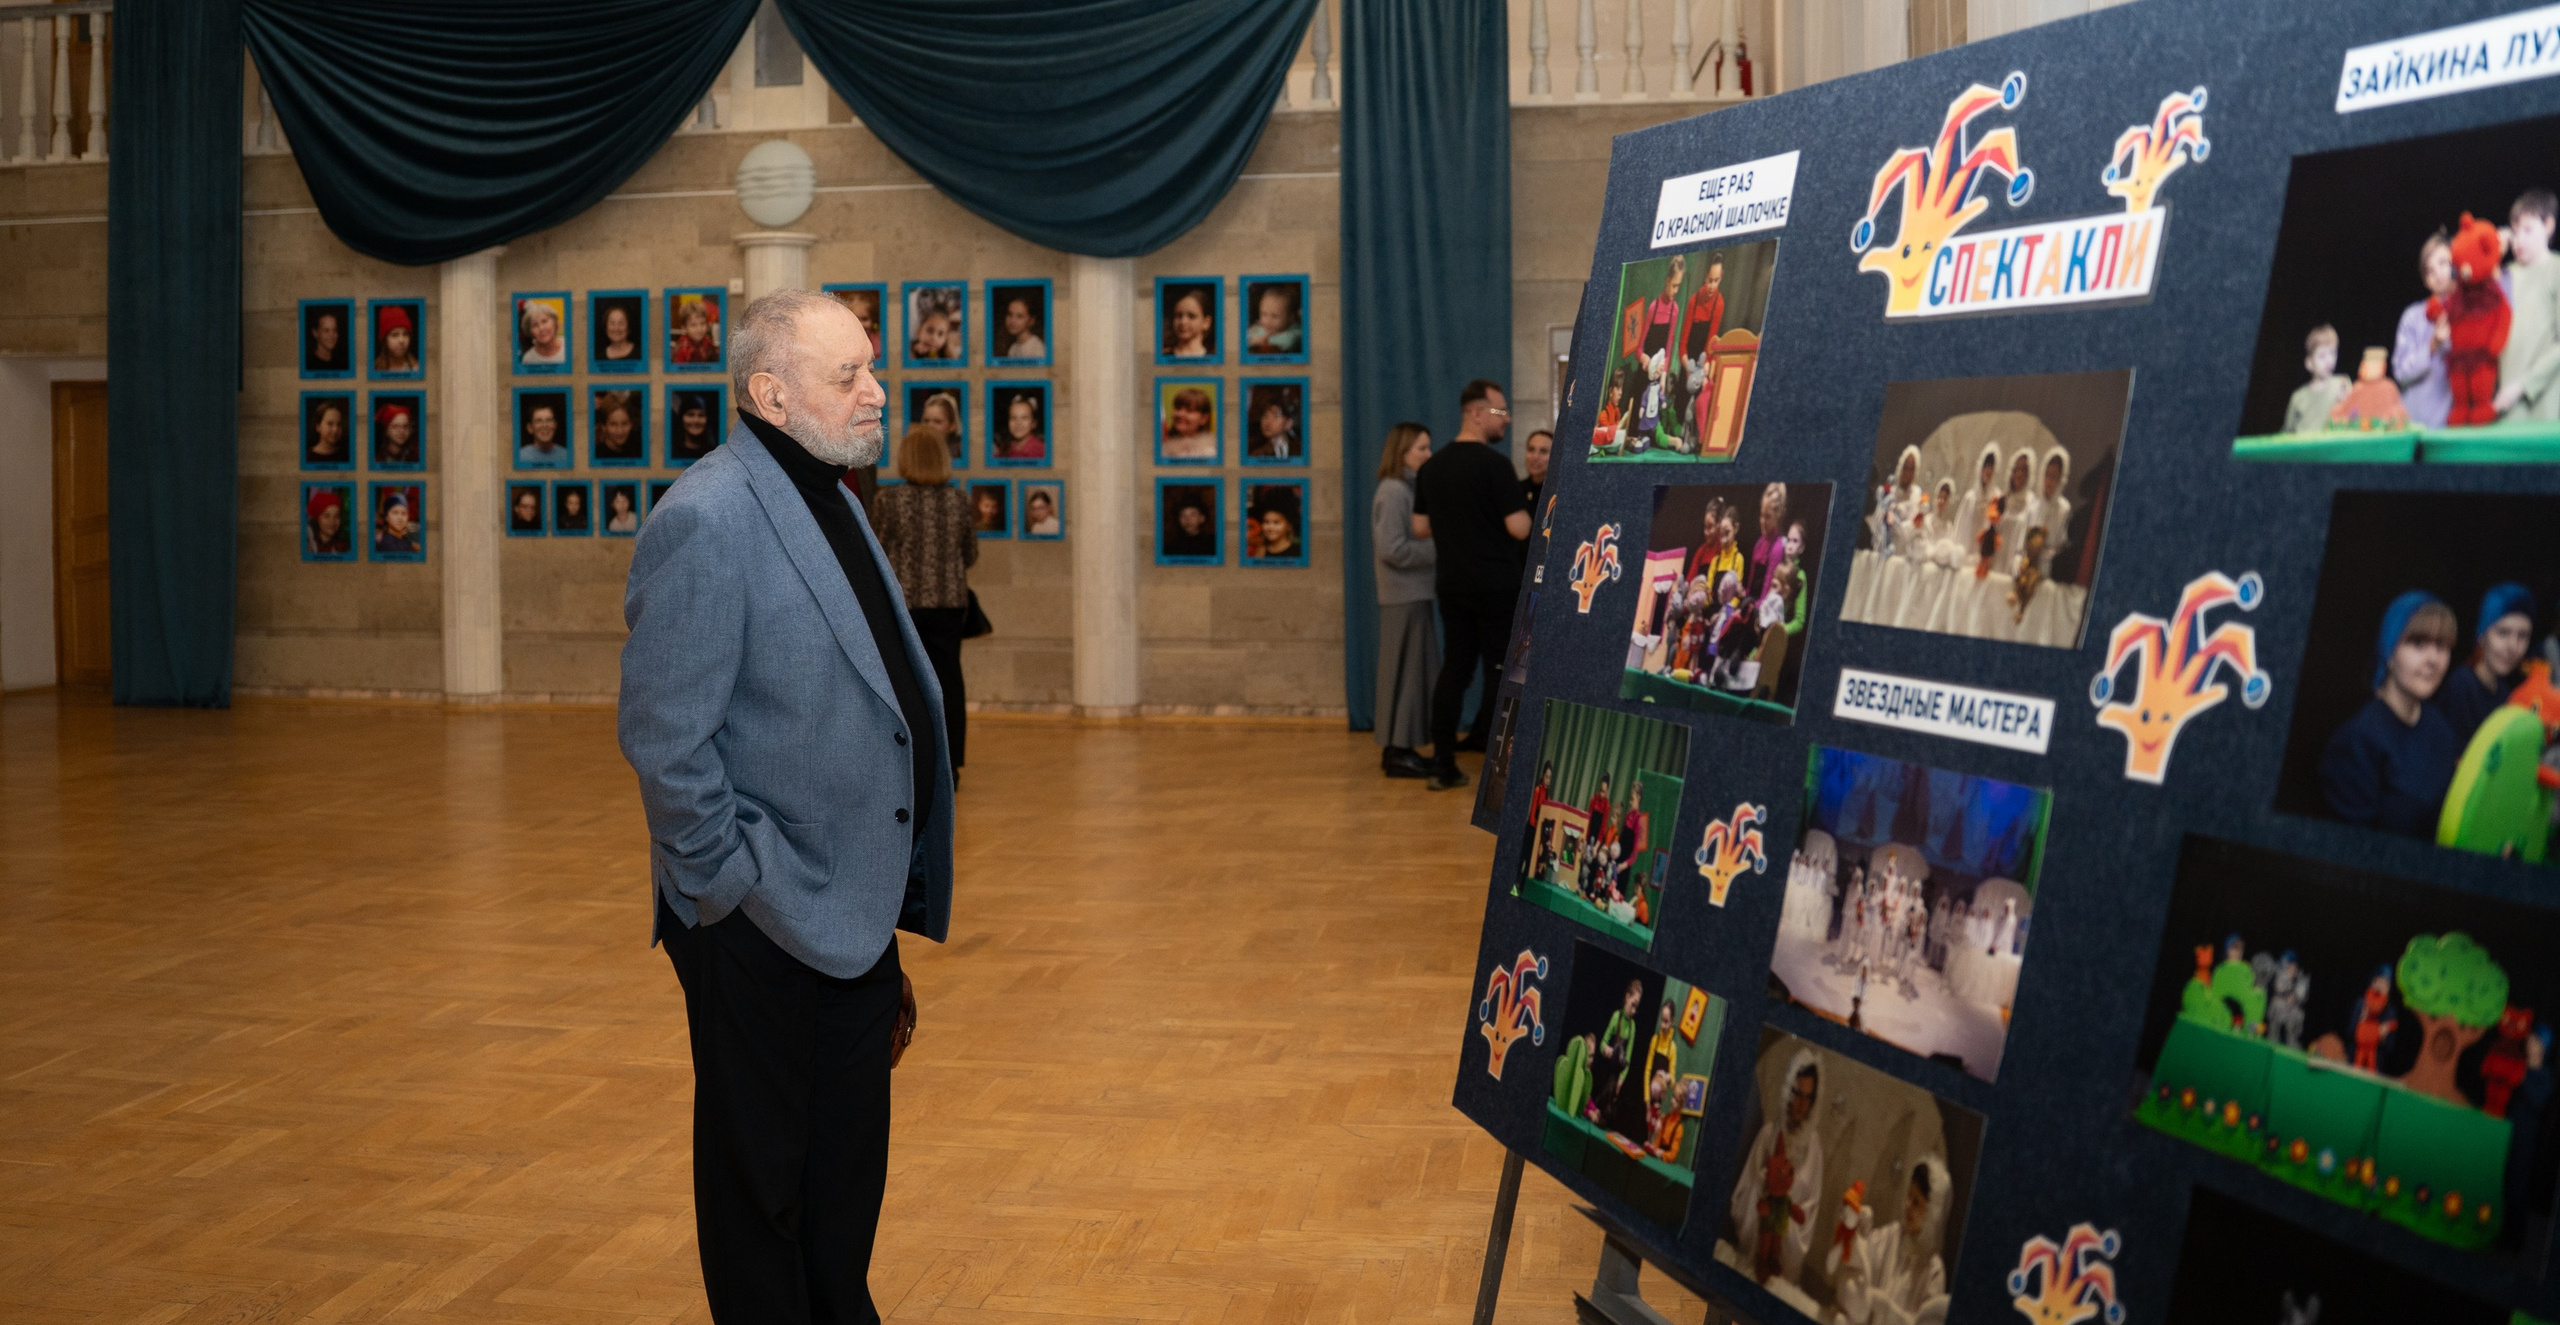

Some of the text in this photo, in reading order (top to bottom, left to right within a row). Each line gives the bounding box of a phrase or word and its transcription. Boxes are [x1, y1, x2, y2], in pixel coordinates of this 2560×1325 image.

[2344, 42, 2489, 99] ЗАЙКИНА
[1698, 170, 1754, 202] ЕЩЕ РАЗ
[1655, 196, 1788, 240] О КРАСНОЙ ШАПОЧКЕ
[1929, 218, 2153, 306] СПЕКТАКЛИ
[1843, 677, 2042, 739] ЗВЕЗДНЫЕ МАСТЕРА
